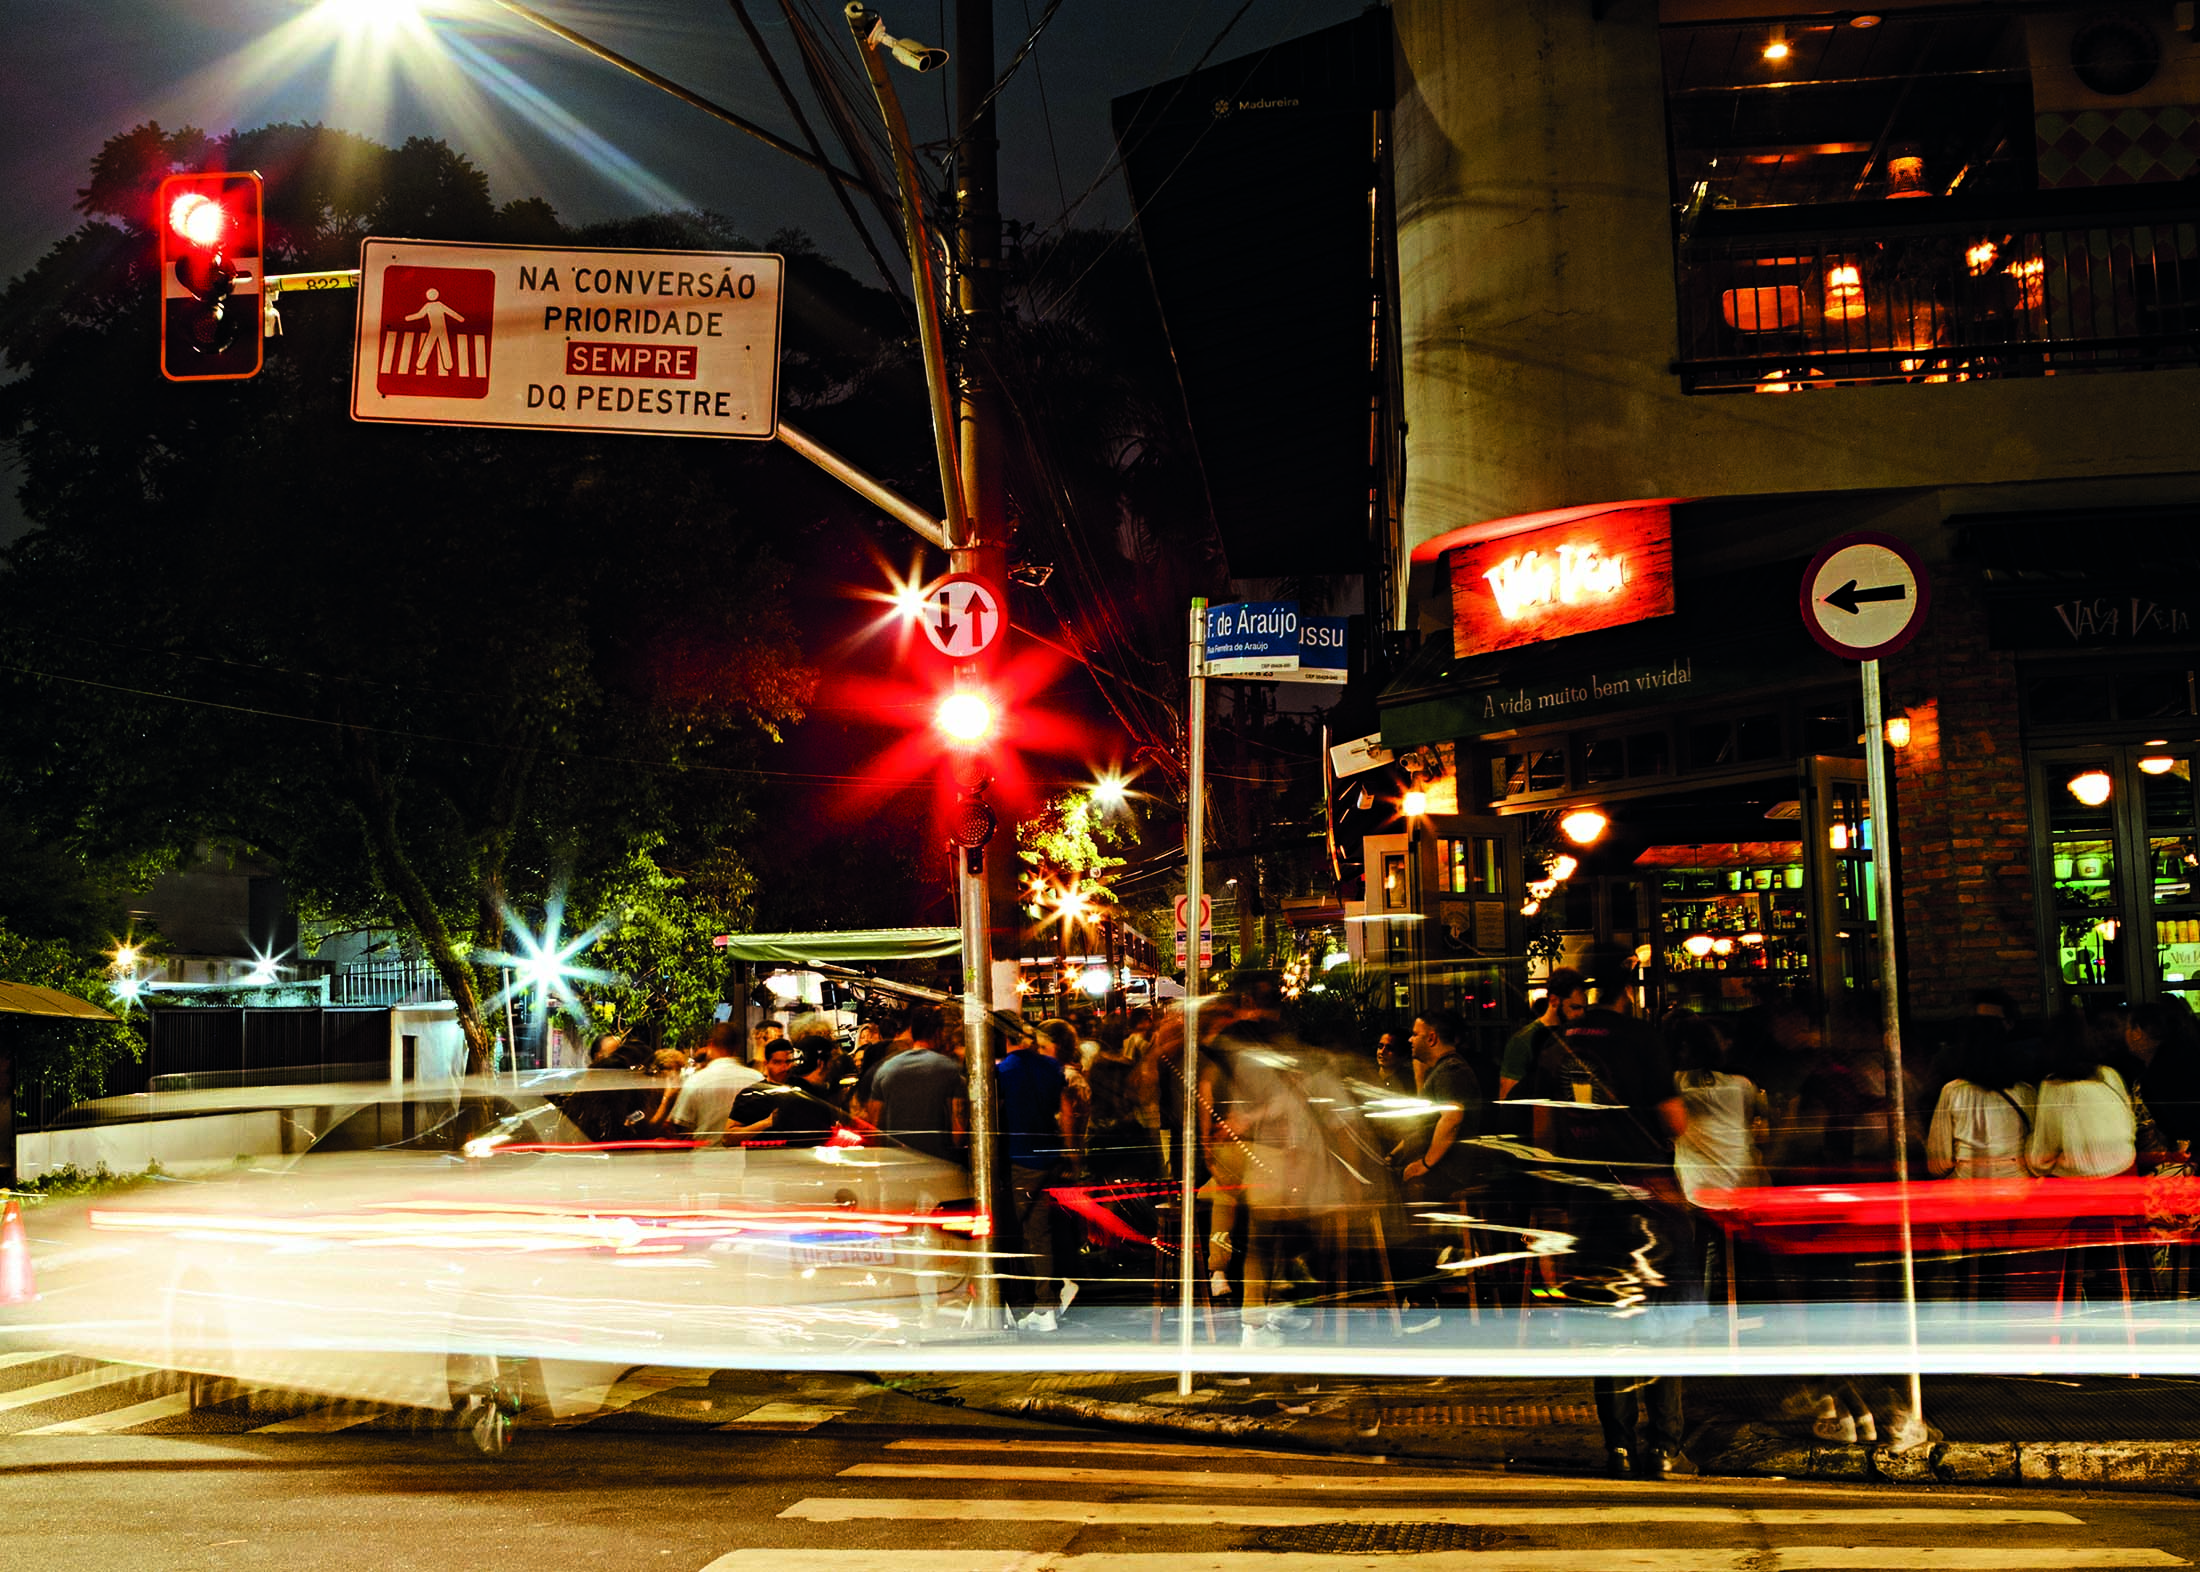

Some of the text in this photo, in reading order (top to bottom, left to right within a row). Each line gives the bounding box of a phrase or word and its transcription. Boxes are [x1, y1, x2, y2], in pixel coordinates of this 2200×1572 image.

[1239, 97, 1299, 110] Madureira
[518, 265, 560, 291] NA
[543, 305, 723, 337] PRIORIDADE
[571, 345, 692, 376] SEMPRE
[527, 384, 731, 417] DO PEDESTRE
[1217, 611, 1233, 636] de
[1236, 607, 1297, 639] Araújo
[1234, 643, 1243, 651] de
[1244, 641, 1269, 652] Araújo
[1483, 657, 1693, 719] A vida muito bem vivida!
